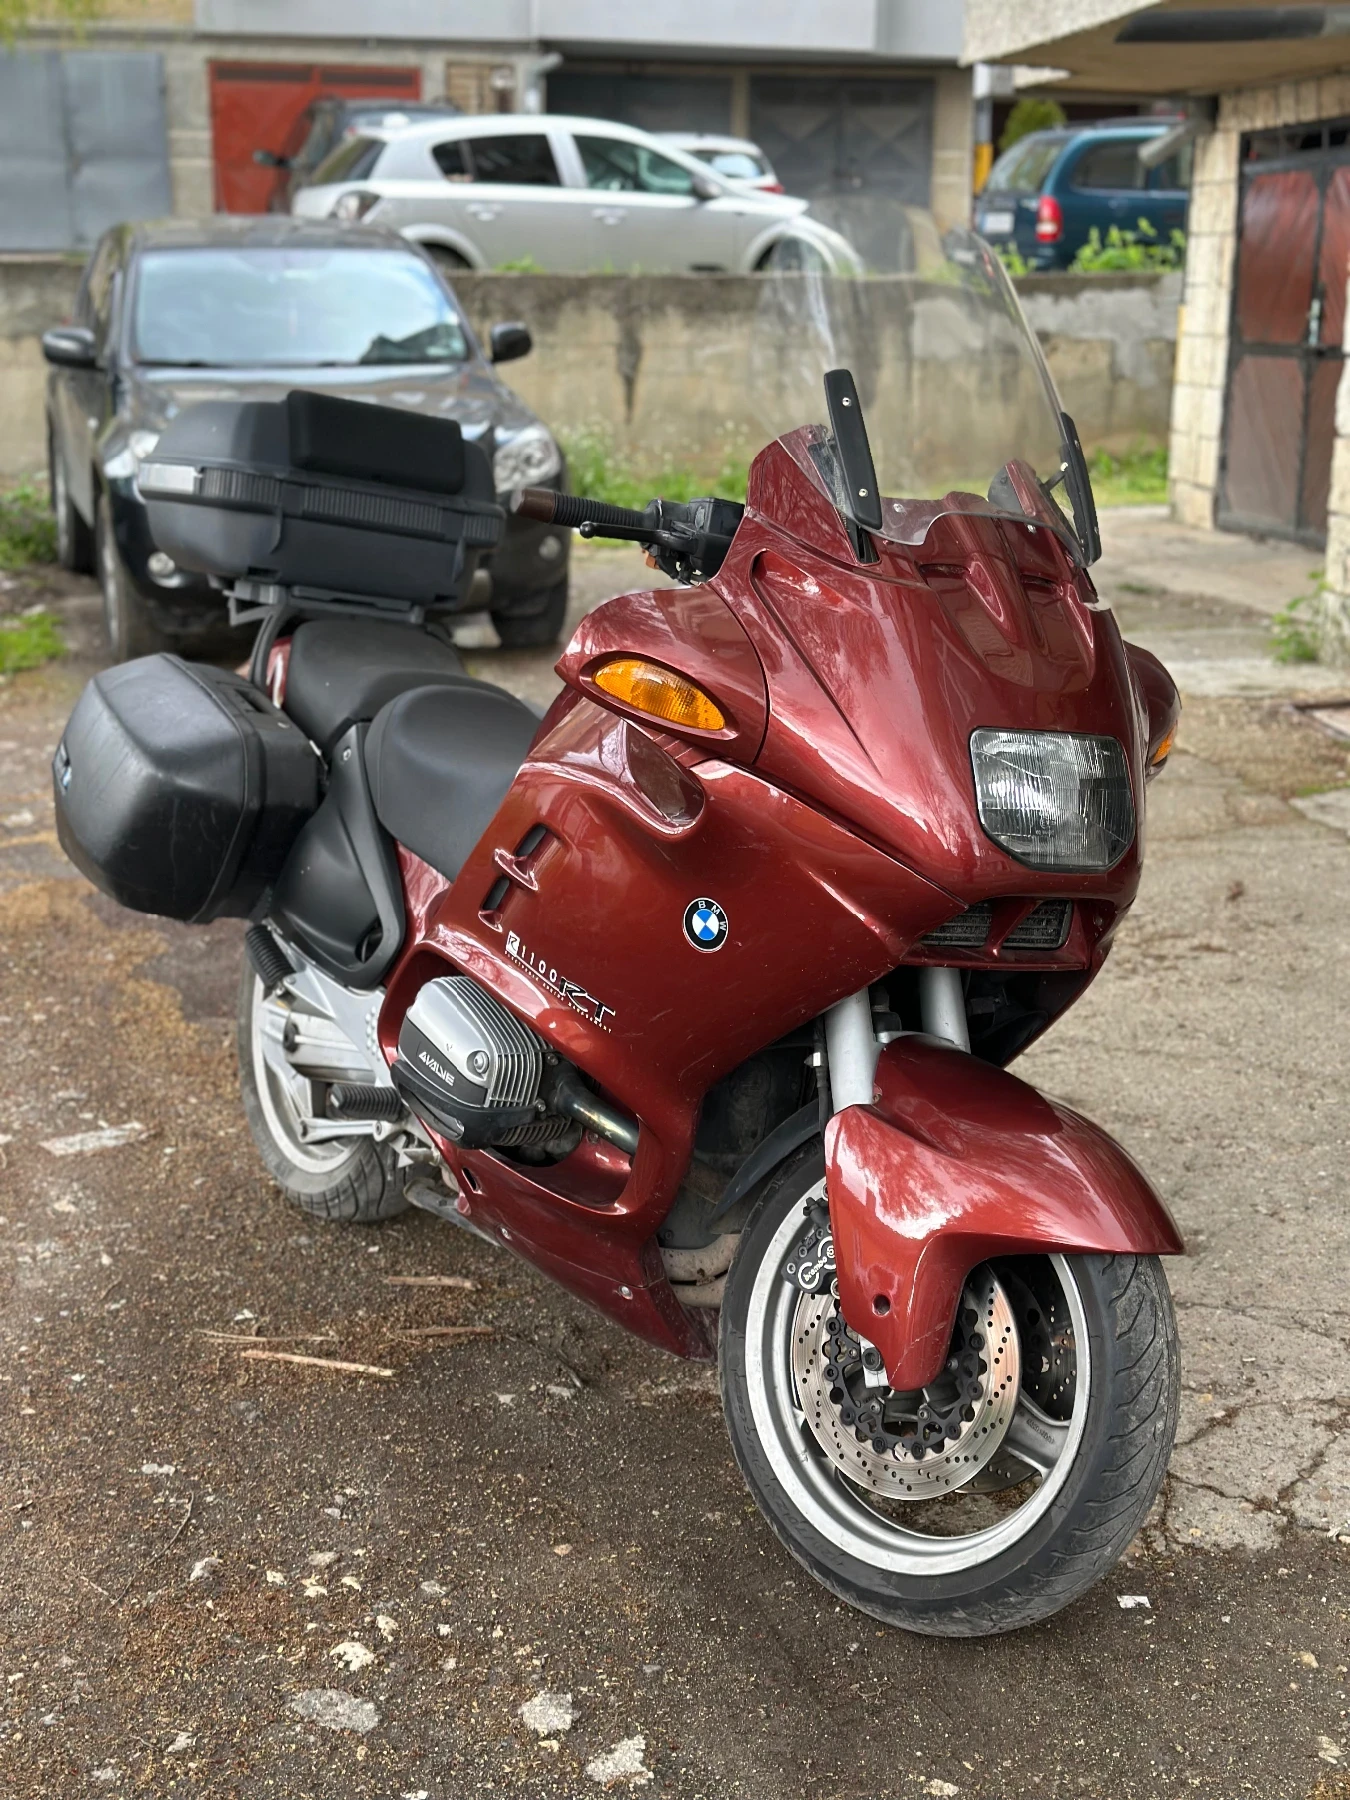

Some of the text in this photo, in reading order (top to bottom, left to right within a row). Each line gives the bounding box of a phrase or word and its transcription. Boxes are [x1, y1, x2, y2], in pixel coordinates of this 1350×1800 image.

[698, 900, 727, 931] BMW
[418, 1051, 455, 1087] 4VALVE
[803, 1256, 828, 1282] brembo
